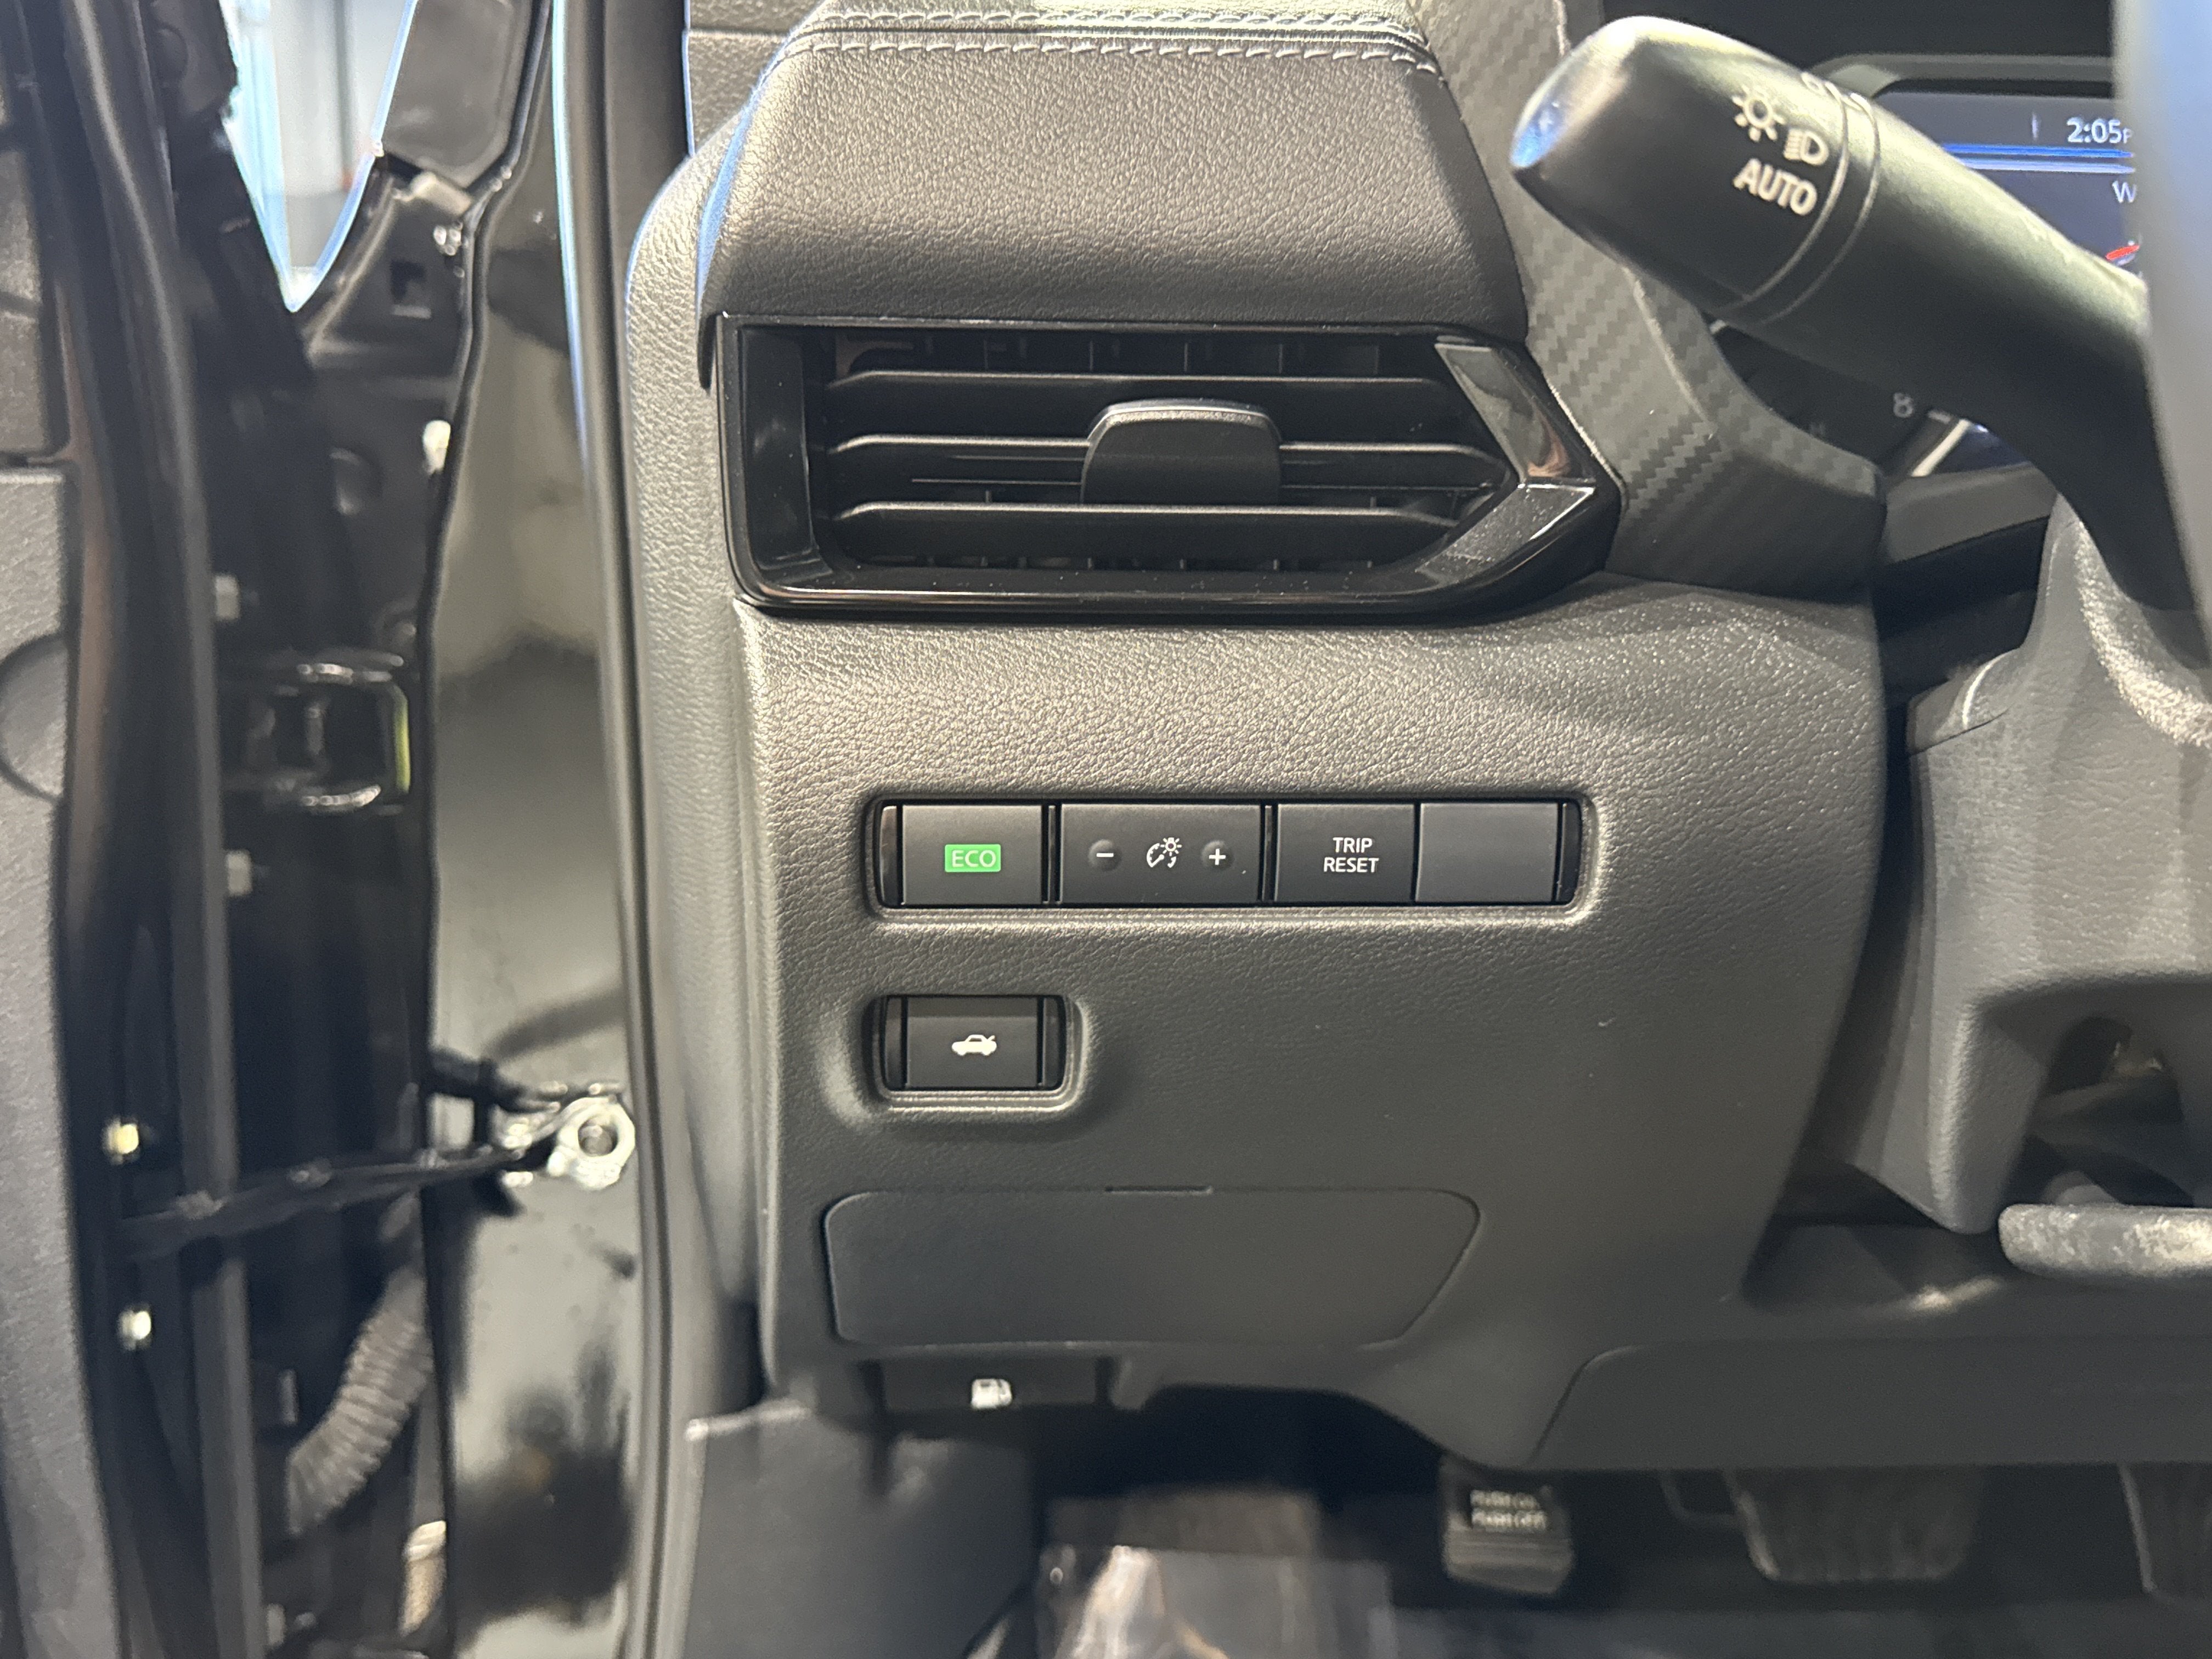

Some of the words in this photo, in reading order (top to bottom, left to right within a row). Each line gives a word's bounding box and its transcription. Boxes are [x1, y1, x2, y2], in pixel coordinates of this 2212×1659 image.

[1733, 157, 1818, 216] AUTO
[1333, 837, 1373, 853] TRIP
[952, 850, 996, 868] ECO
[1323, 856, 1379, 873] RESET
